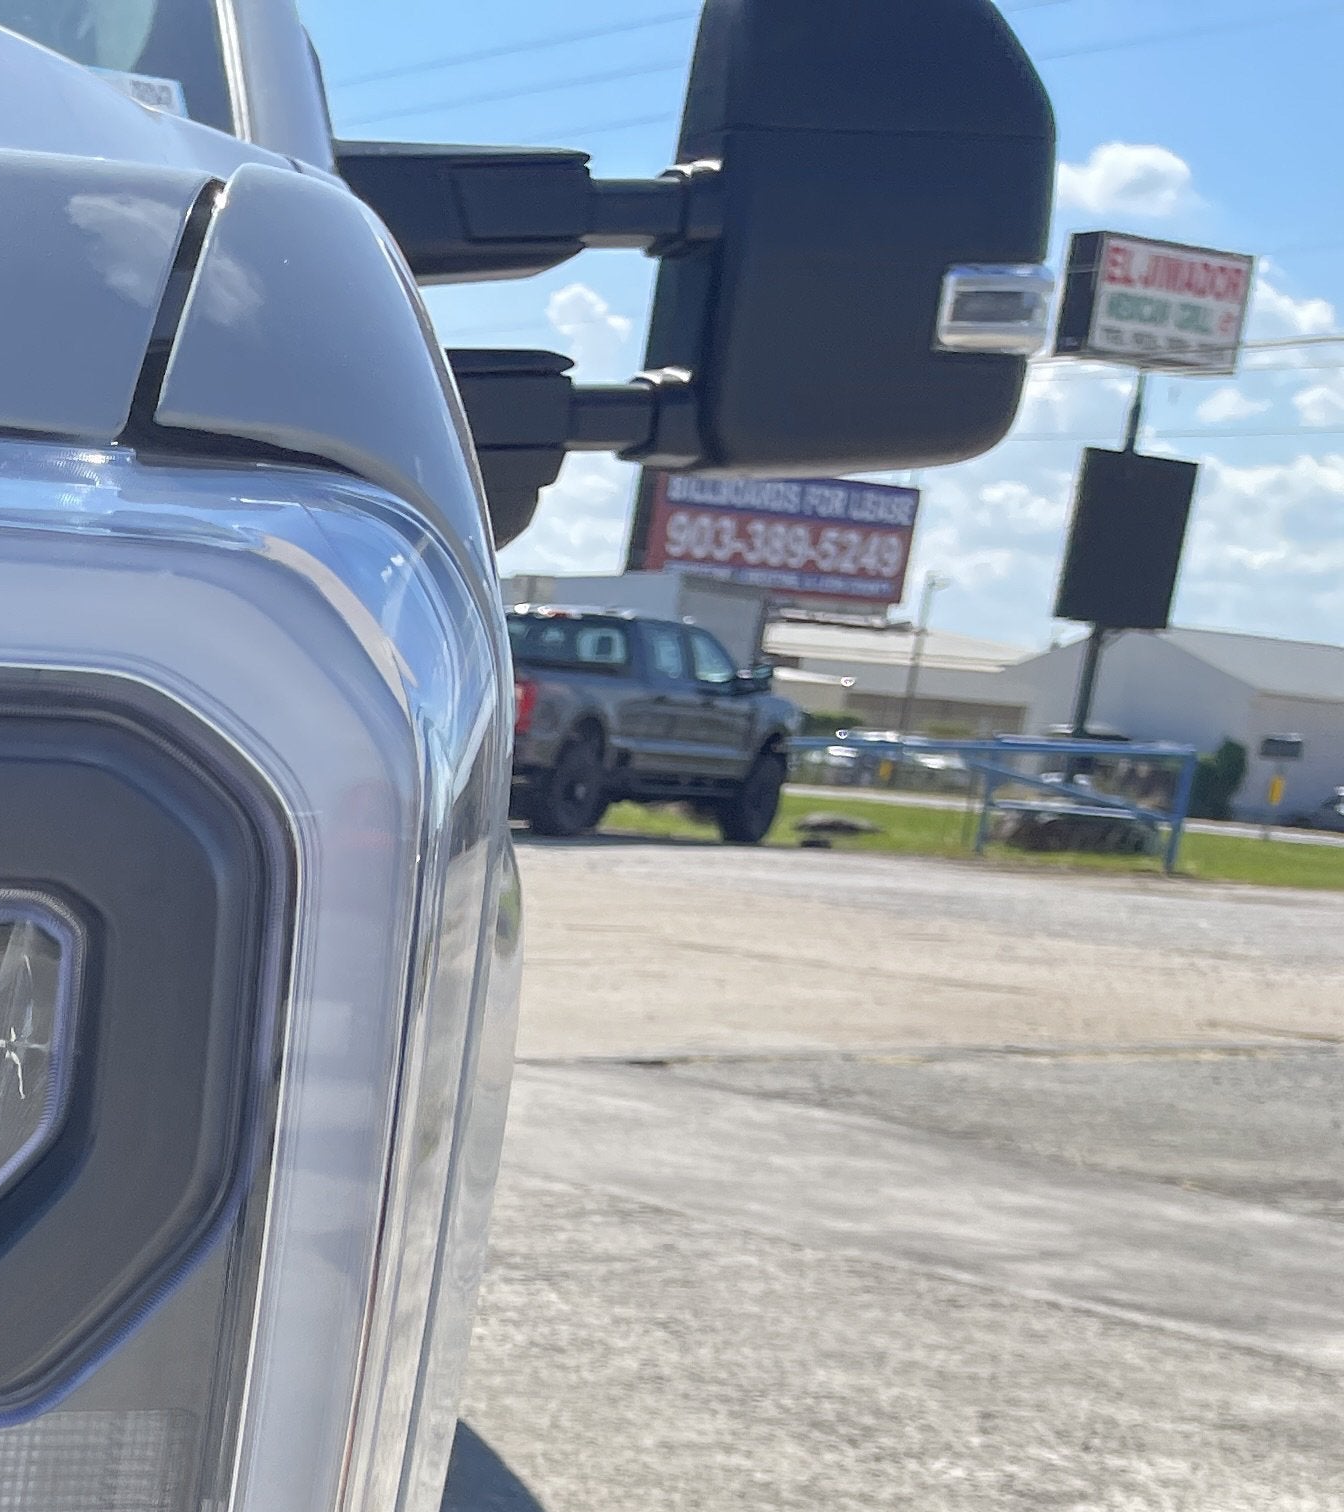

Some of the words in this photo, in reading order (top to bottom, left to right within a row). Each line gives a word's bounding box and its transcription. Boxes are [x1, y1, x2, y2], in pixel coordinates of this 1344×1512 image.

[1104, 244, 1135, 287] EL
[666, 475, 801, 515] BILLBOARDS
[804, 484, 848, 518] FOR
[850, 490, 914, 527] LEASE
[665, 510, 904, 578] 903-389-5249
